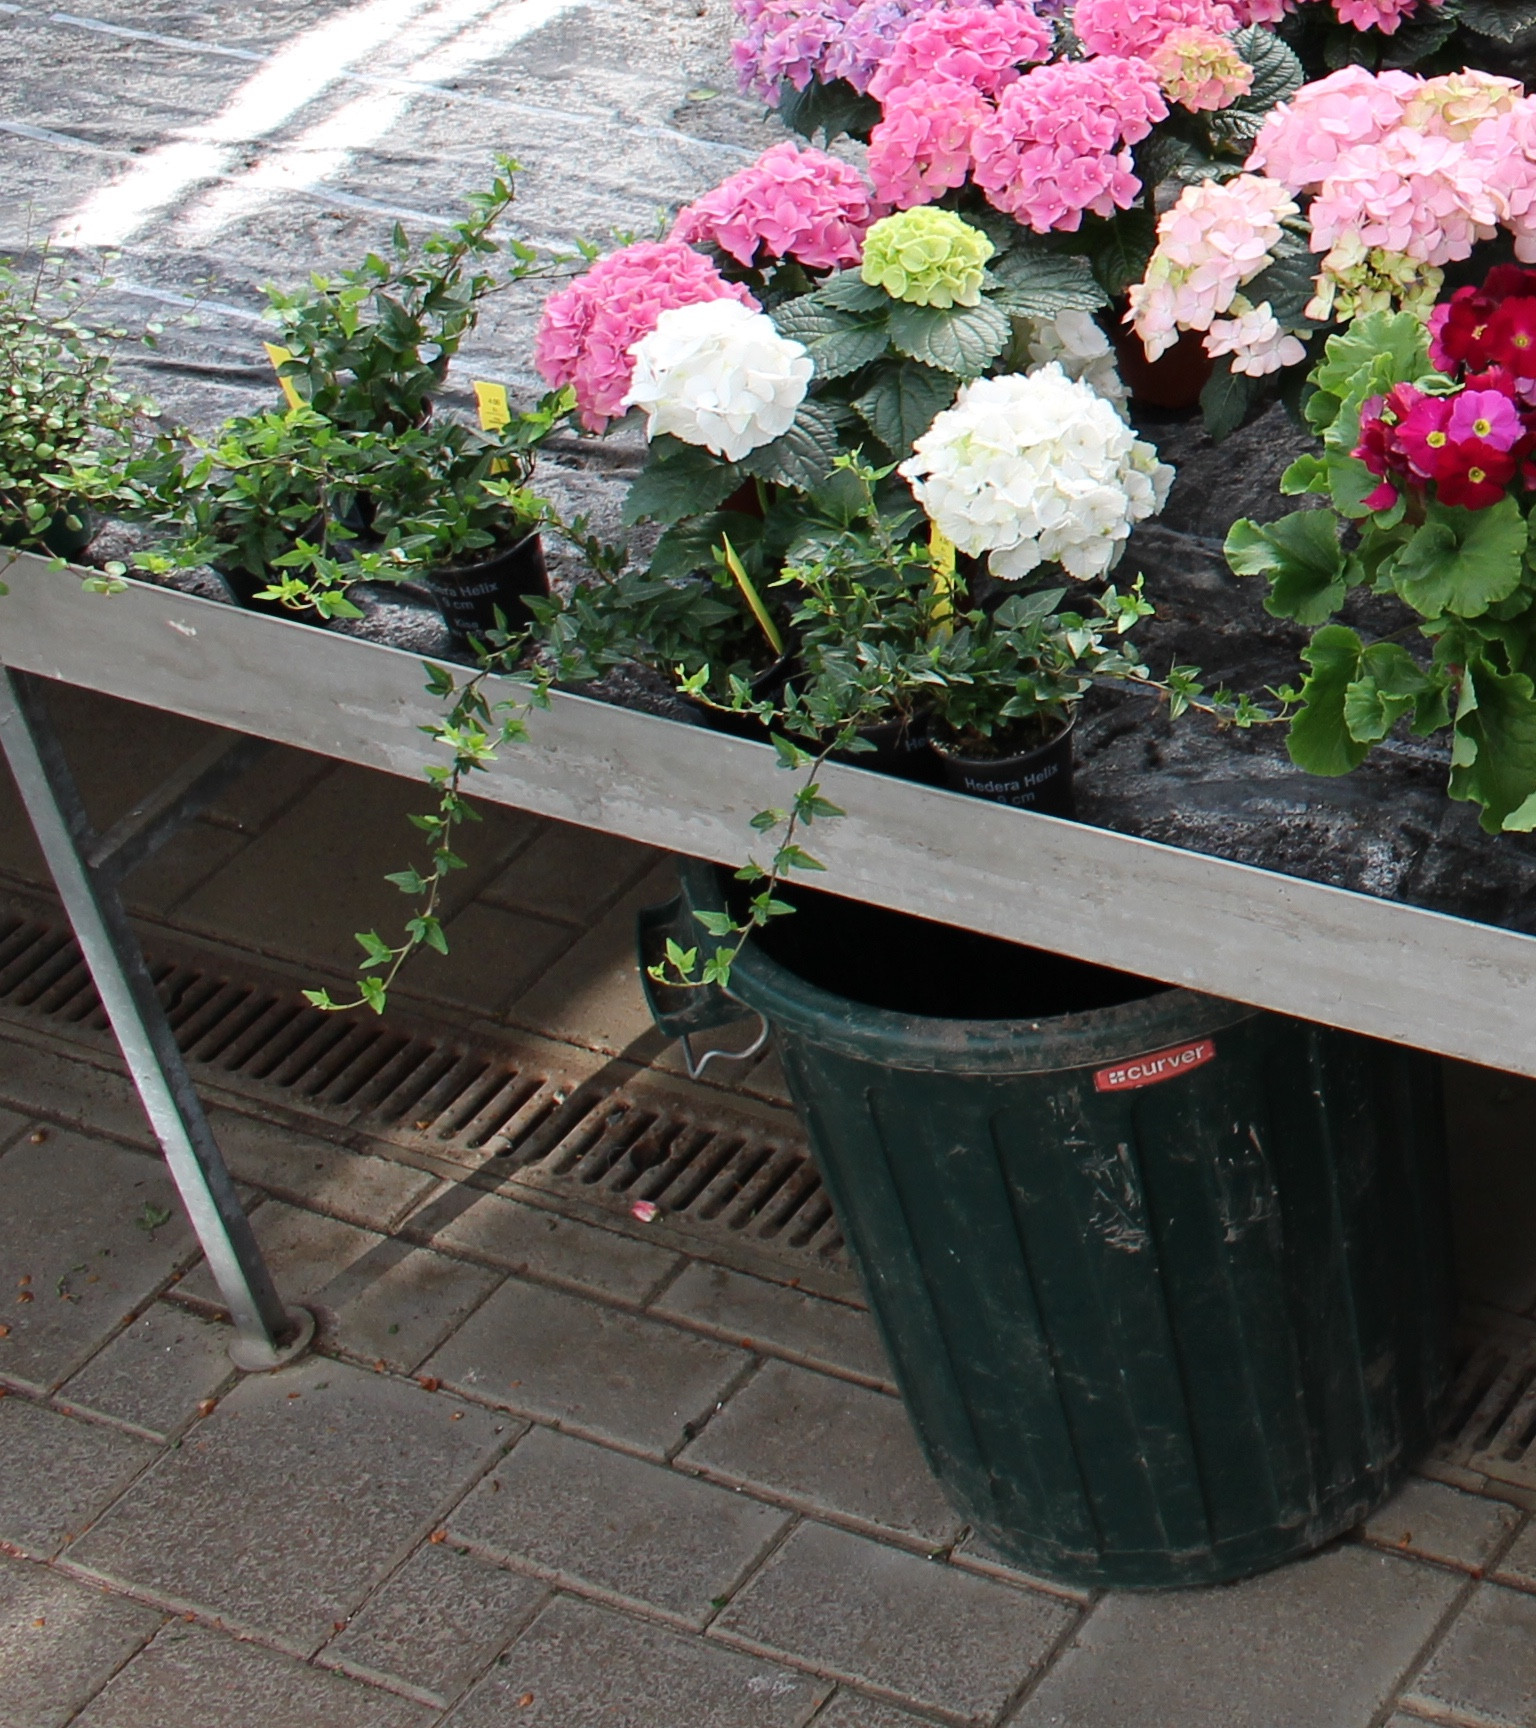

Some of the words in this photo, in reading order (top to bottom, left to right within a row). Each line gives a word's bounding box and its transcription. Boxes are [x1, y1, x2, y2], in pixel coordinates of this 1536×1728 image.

[458, 581, 499, 597] Helix
[452, 600, 475, 610] cm
[963, 776, 1020, 793] Hedera
[1024, 763, 1059, 788] Helix
[1011, 791, 1036, 806] cm
[1126, 1044, 1205, 1082] curver
